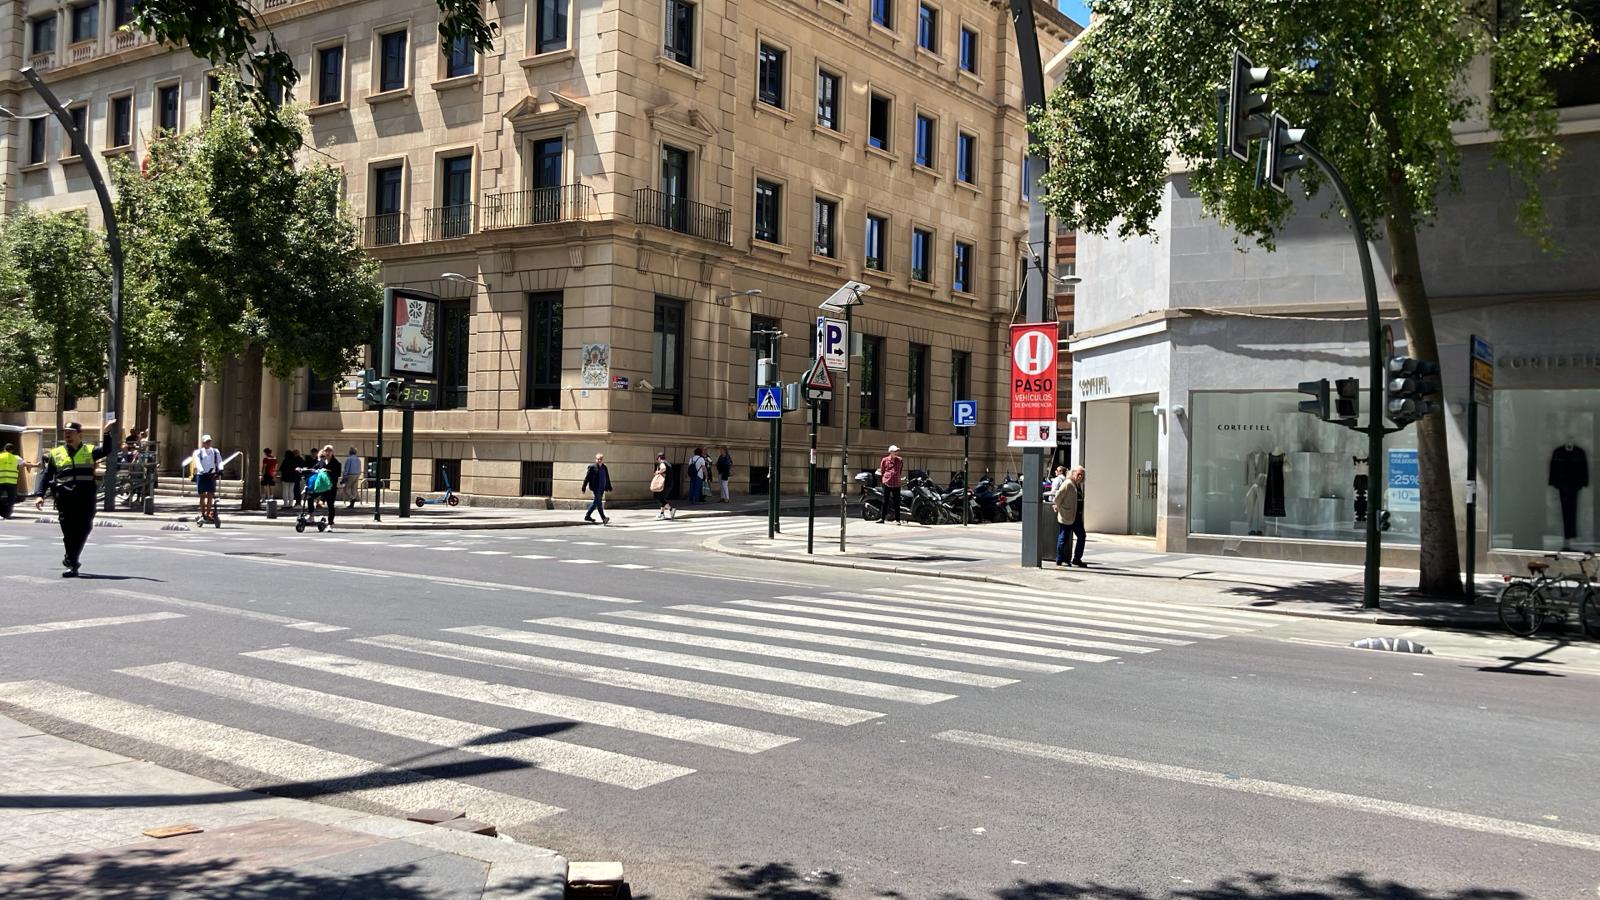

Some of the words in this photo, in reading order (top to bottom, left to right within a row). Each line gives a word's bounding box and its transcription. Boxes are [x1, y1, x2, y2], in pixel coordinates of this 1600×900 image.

[826, 324, 842, 354] P
[1497, 355, 1600, 369] CORTEFIE
[1015, 378, 1052, 392] PASO
[1014, 393, 1052, 401] VEHÍCULOS
[958, 403, 973, 424] P
[1391, 474, 1420, 486] -25%
